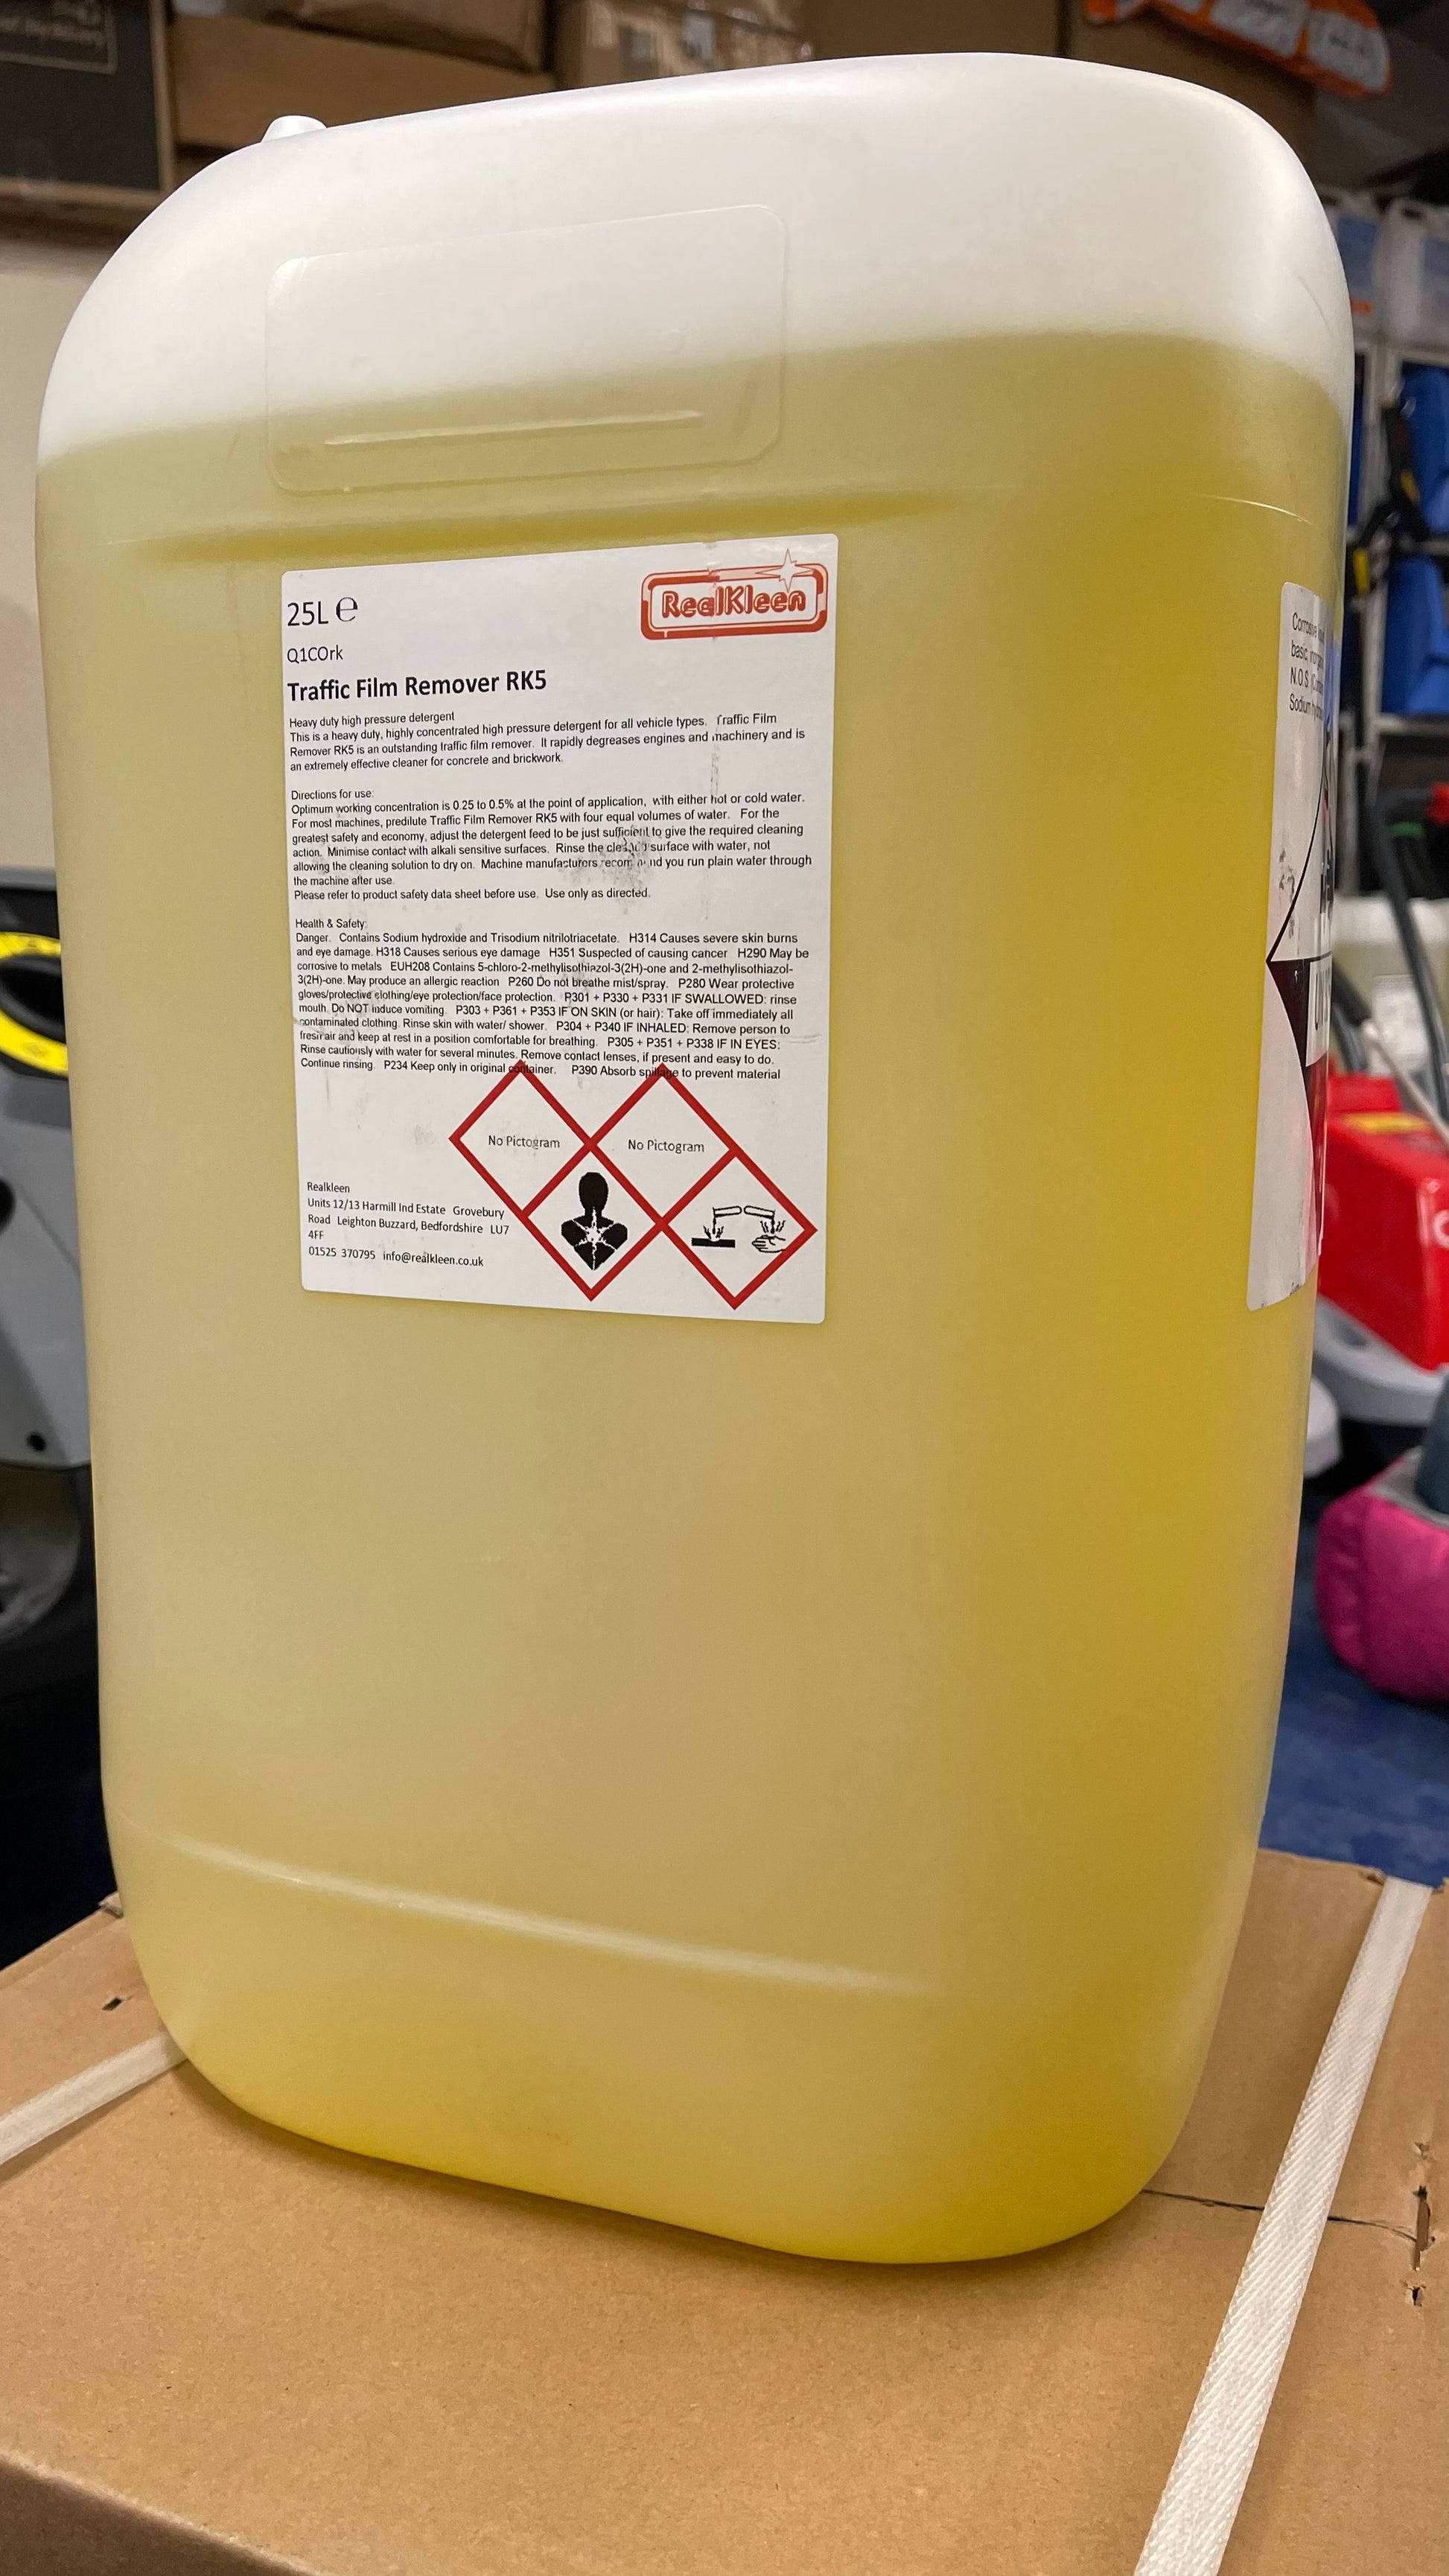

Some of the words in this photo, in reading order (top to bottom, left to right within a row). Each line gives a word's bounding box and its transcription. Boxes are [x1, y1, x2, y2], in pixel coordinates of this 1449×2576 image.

[662, 584, 806, 617] RealKleen
[287, 602, 328, 626] 25L
[287, 645, 343, 663] Q1COrk
[287, 679, 349, 701] Traffic
[357, 678, 397, 698] Film
[405, 677, 499, 695] Remover
[506, 670, 546, 690] RK5
[1290, 693, 1311, 713] Sodium
[290, 718, 316, 729] Heavy
[319, 716, 339, 727] duty
[342, 715, 361, 727] high
[364, 715, 406, 727] pressure
[409, 712, 454, 724] detergent
[290, 732, 309, 742] This
[313, 732, 320, 741] is
[331, 731, 357, 742] heavy
[360, 730, 383, 741] duty,
[386, 727, 413, 740] highly
[416, 725, 479, 736] concentrated
[483, 724, 503, 736] high
[506, 724, 550, 736] pressure
[553, 720, 601, 733] detergent
[605, 719, 618, 729] for
[621, 718, 632, 728] all
[636, 717, 672, 728] vehicle
[676, 717, 707, 729] types.
[717, 713, 749, 725] Traffic
[753, 713, 776, 724] Film
[305, 759, 348, 771] extremely
[351, 759, 389, 768] effective
[392, 758, 427, 767] cleaner
[431, 756, 443, 766] for
[446, 756, 488, 765] concrete
[491, 753, 509, 764] and
[513, 753, 563, 763] brickwork.
[291, 790, 337, 800] Directions
[339, 788, 351, 798] for
[291, 805, 333, 816] Optimum
[335, 803, 371, 817] working
[375, 802, 439, 812] concentration
[442, 800, 450, 810] is
[453, 800, 474, 810] 0.25
[477, 800, 485, 809] to
[489, 799, 514, 809] 0.5%
[517, 799, 526, 809] at
[529, 798, 544, 808] the
[548, 797, 572, 810] point
[575, 797, 585, 807] of
[587, 796, 646, 809] application,
[652, 794, 673, 805] with
[677, 794, 707, 805] either
[710, 794, 727, 804] hot
[730, 795, 741, 803] or
[745, 792, 767, 803] cold
[771, 792, 804, 803] water.
[293, 876, 308, 885] the
[310, 876, 348, 885] machine
[351, 875, 372, 885] after
[294, 890, 325, 899] Please
[328, 890, 348, 899] refer
[351, 890, 360, 899] to
[363, 890, 397, 901] product
[400, 889, 428, 901] safety
[431, 889, 451, 899] data
[455, 889, 480, 899] sheet
[484, 888, 515, 898] before
[545, 888, 564, 898] Use
[568, 888, 588, 900] only
[591, 890, 603, 898] as
[606, 887, 650, 897] directed.
[296, 919, 324, 928] Health
[327, 919, 333, 928] &
[296, 933, 331, 944] Danger.
[339, 933, 380, 942] Contains
[383, 933, 418, 942] Sodium
[421, 933, 466, 944] hydroxide
[469, 933, 487, 943] and
[491, 933, 539, 943] Trisodium
[543, 933, 619, 943] nitrilotriacetate.
[629, 933, 656, 943] H314
[660, 933, 699, 943] Causes
[742, 932, 762, 943] skin
[767, 933, 797, 943] burns
[296, 947, 313, 956] and
[316, 949, 331, 958] eye
[334, 947, 372, 958] damage.
[376, 946, 401, 956] H318
[404, 947, 439, 957] Causes
[442, 947, 477, 957] serious
[480, 949, 497, 959] eye
[500, 948, 540, 960] damage
[550, 947, 574, 957] H351
[579, 948, 631, 960] Suspected
[635, 948, 645, 957] of
[648, 948, 688, 960] causing
[691, 950, 727, 958] cancer
[738, 948, 766, 958] H290
[769, 948, 792, 960] May
[795, 948, 809, 958] be
[297, 961, 337, 970] corrosive
[340, 962, 348, 971] to
[351, 961, 382, 971] metals
[390, 961, 430, 971] EUH208
[433, 962, 475, 972] Contains
[669, 963, 688, 973] and
[692, 963, 793, 975] 2-methylisothiazol-
[348, 975, 366, 986] May
[369, 975, 406, 986] produce
[424, 976, 457, 988] allergic
[461, 977, 499, 986] reaction
[509, 977, 533, 986] P260
[537, 976, 550, 986] Do
[554, 978, 568, 986] not
[572, 977, 609, 987] breathe
[613, 978, 668, 990] mist/spray.
[678, 978, 705, 988] P280
[708, 978, 738, 989] Wear
[742, 979, 794, 991] protective
[488, 1135, 503, 1146] No
[506, 1135, 560, 1150] Pictogram
[628, 1139, 643, 1150] No
[647, 1139, 704, 1154] Pictogram
[307, 1182, 349, 1193] Realkleen
[308, 1198, 330, 1208] Units
[333, 1199, 359, 1211] 12/13
[363, 1201, 395, 1211] Harmill
[399, 1203, 413, 1213] Ind
[416, 1204, 445, 1214] Estate
[453, 1206, 504, 1220] Grovebury
[308, 1214, 330, 1224] Road
[337, 1216, 376, 1228] Leighton
[379, 1218, 418, 1231] Buzzard,
[421, 1221, 483, 1233] Bedfordshire
[491, 1225, 509, 1234] LU7
[308, 1230, 323, 1239] 4FF
[308, 1246, 336, 1257] 01525
[341, 1249, 375, 1259] 370795
[383, 1252, 483, 1266] info@realkleen.co.uk
